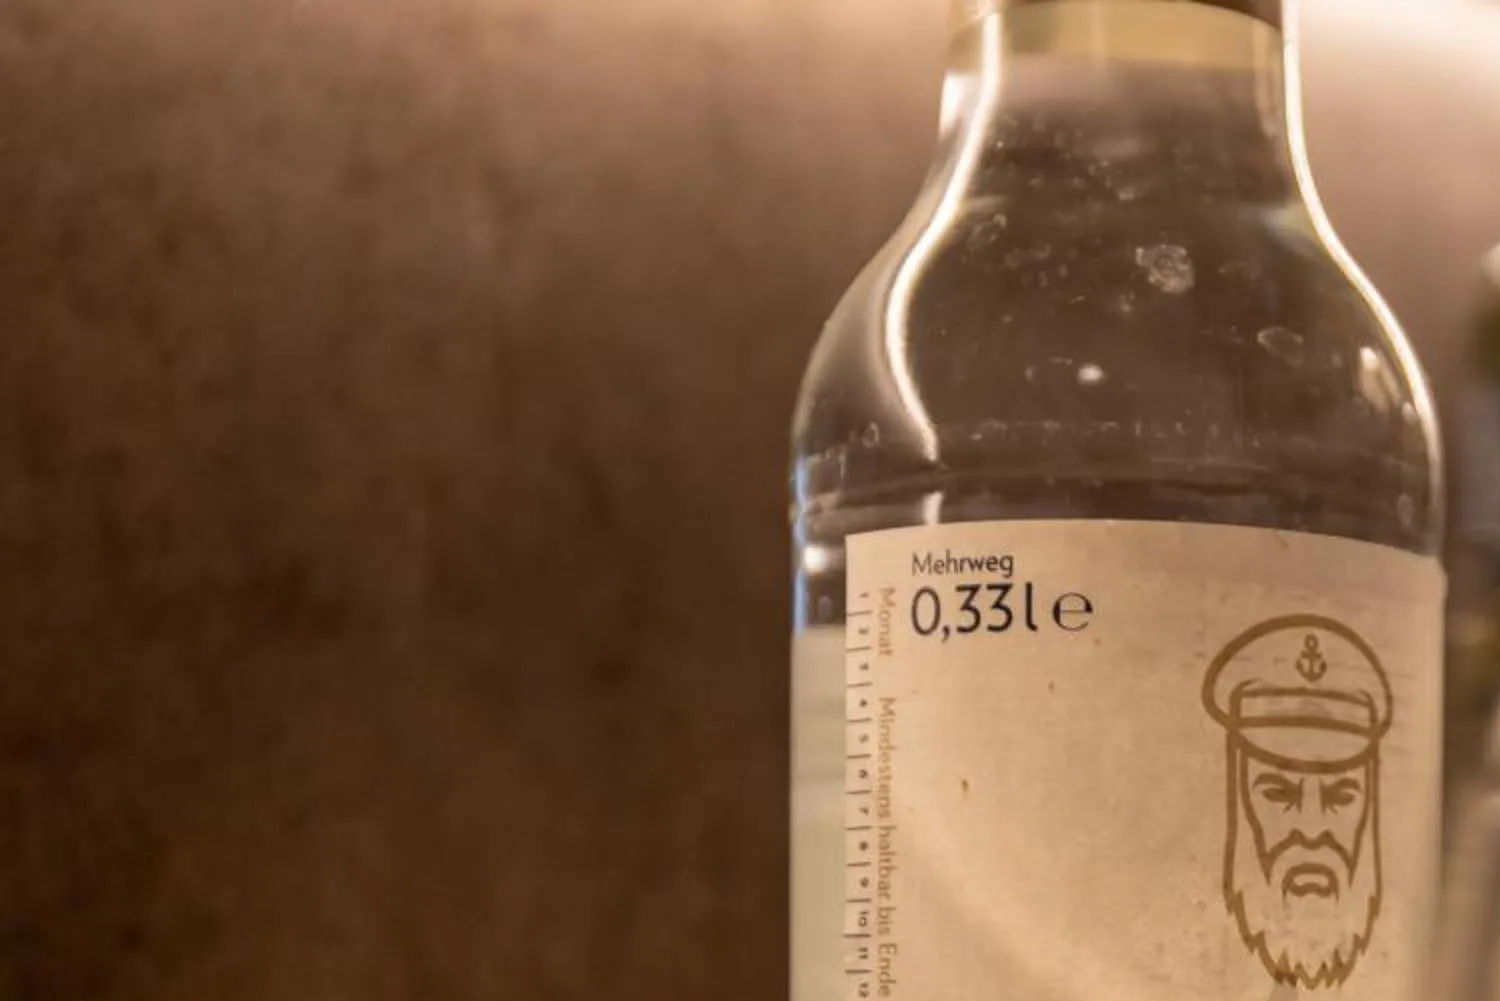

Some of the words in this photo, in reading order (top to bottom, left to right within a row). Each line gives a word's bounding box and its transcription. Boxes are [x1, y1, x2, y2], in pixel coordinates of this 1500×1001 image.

[911, 549, 1014, 579] Mehrweg
[878, 587, 897, 656] Monat
[878, 697, 898, 818] Mindestens
[877, 825, 898, 900] haltbar
[858, 910, 869, 927] 10
[877, 906, 897, 936] bis
[858, 982, 869, 998] 12
[878, 943, 897, 997] Ende
